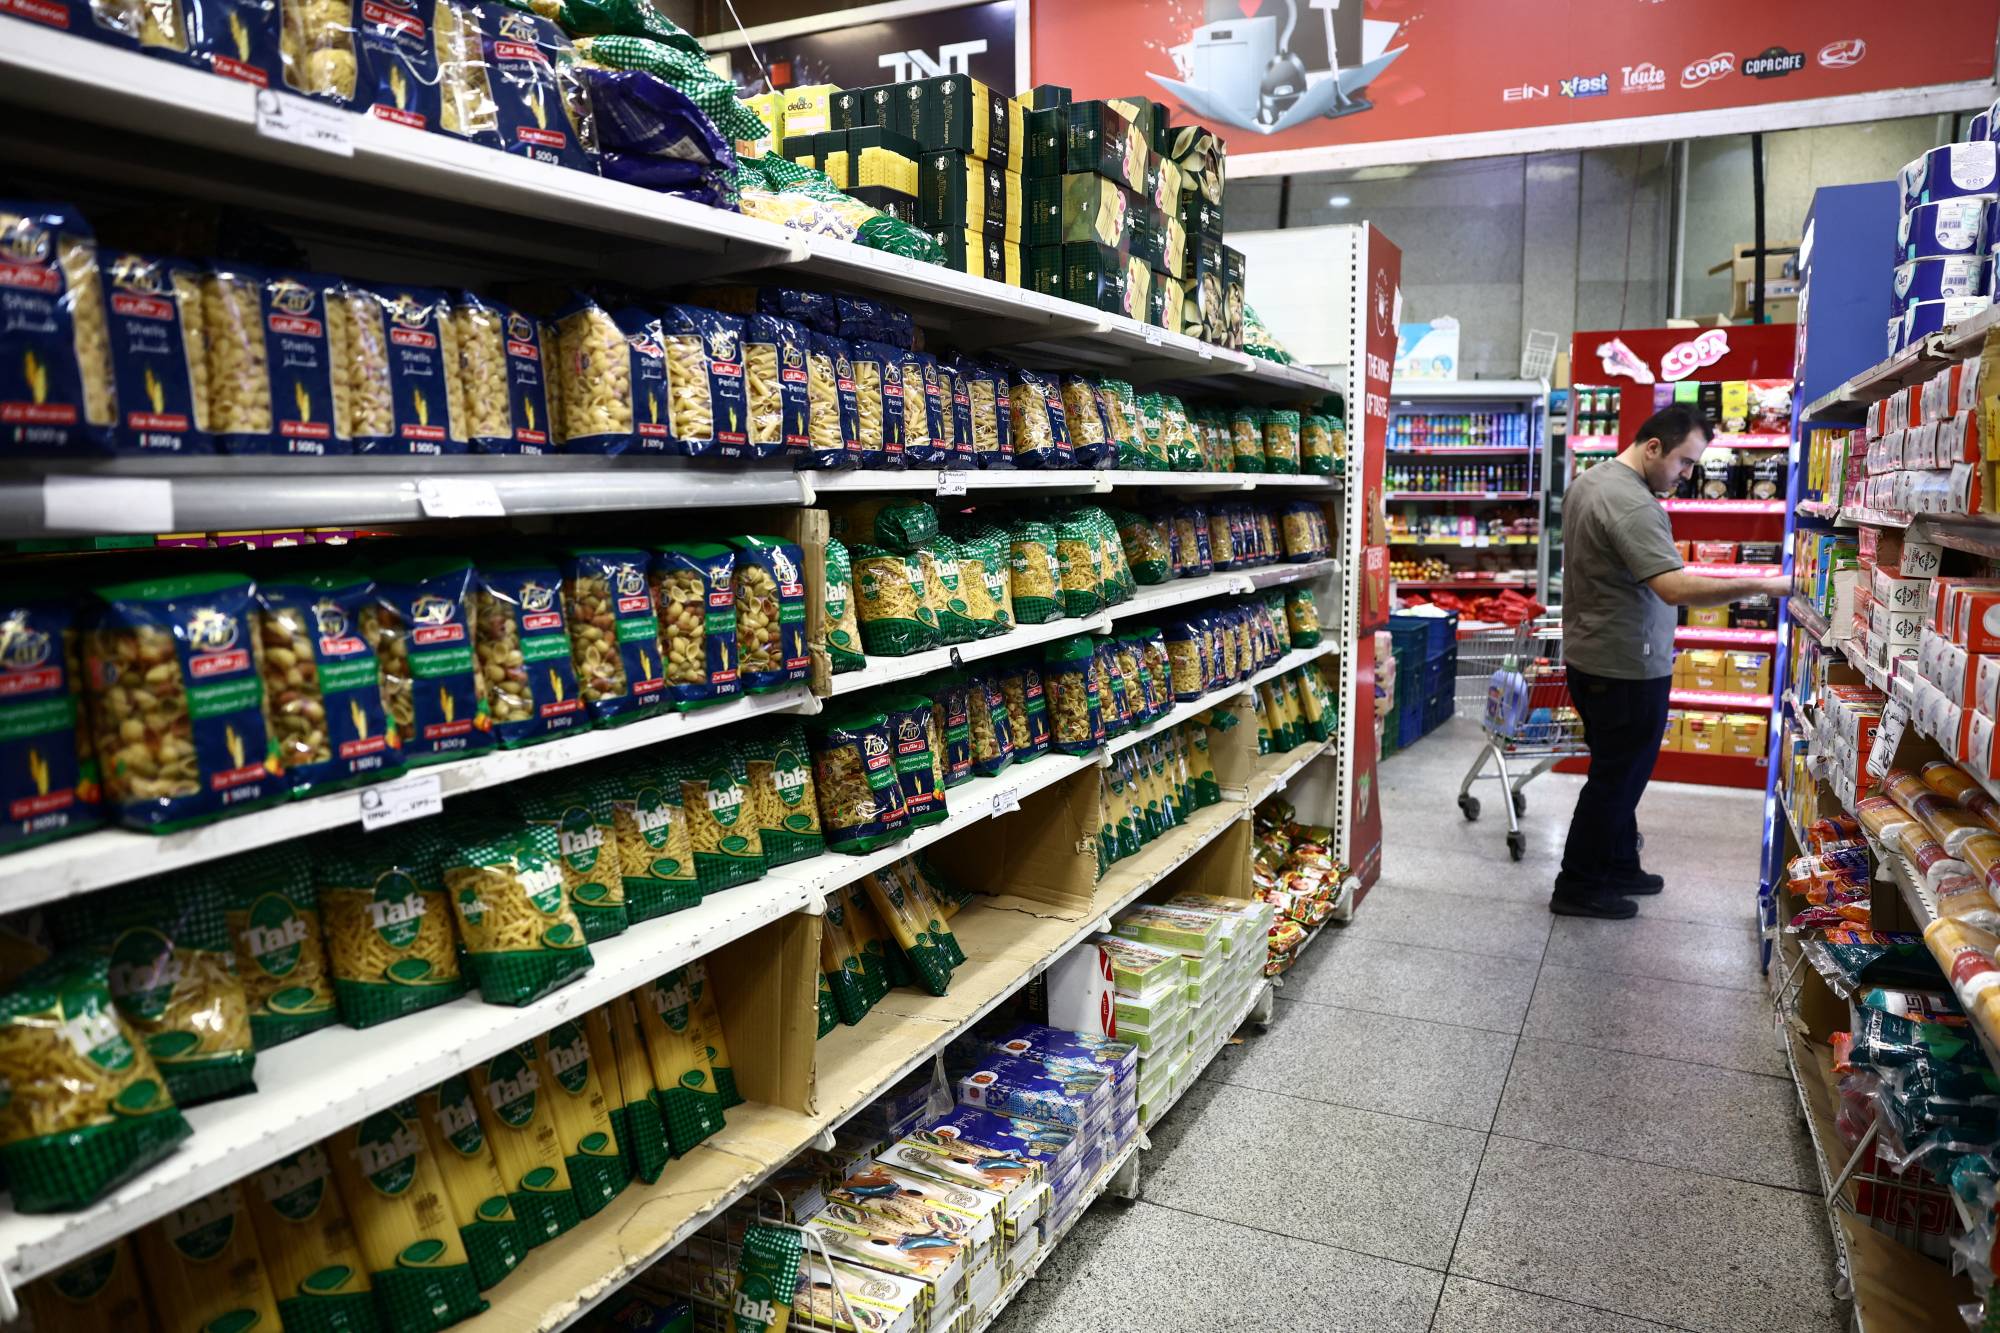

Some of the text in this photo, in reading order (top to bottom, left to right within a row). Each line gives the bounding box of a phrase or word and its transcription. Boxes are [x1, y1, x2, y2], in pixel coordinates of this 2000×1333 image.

[879, 39, 987, 83] TNT
[1621, 65, 1665, 86] Toute
[1684, 60, 1733, 81] COPA
[281, 338, 315, 354] Shells
[401, 350, 431, 363] Shells
[1661, 337, 1722, 371] COPA
[933, 556, 960, 577] Tak
[899, 721, 920, 740] Zar
[865, 736, 888, 755] Zar
[770, 767, 809, 791] Tak
[704, 785, 745, 811] Tak
[915, 794, 932, 803] Macaron
[632, 805, 673, 833] Tak
[561, 826, 605, 856] Tak
[515, 861, 564, 897] Tak
[365, 893, 428, 929] Tak
[240, 917, 308, 957] Tak
[651, 980, 691, 1014] Tak
[545, 1039, 591, 1077] Tak
[484, 1068, 541, 1112] Tak
[352, 1126, 425, 1178] Tak
[735, 1289, 776, 1327] Tak
